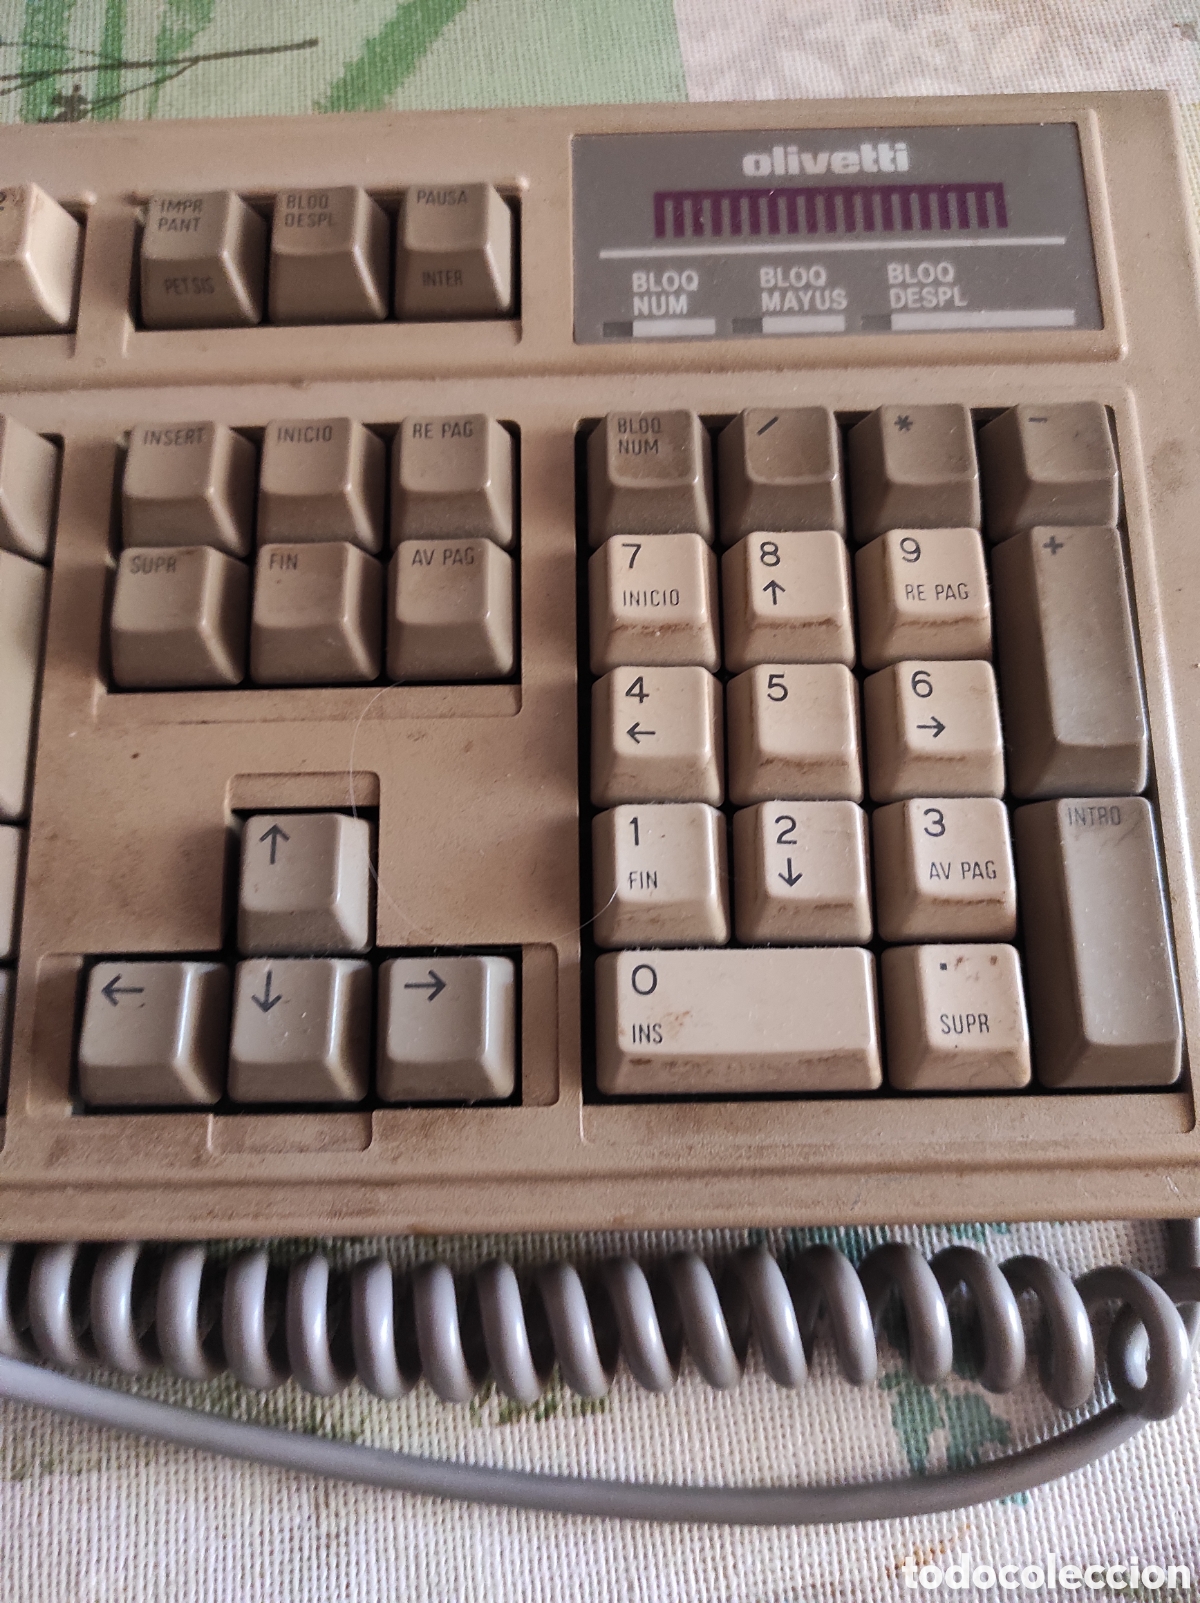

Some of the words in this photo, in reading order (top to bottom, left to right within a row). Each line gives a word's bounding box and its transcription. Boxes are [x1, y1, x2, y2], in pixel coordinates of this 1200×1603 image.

[742, 142, 911, 177] olivetti
[159, 199, 203, 214] IMPR
[416, 189, 468, 206] PAUSA
[157, 217, 201, 232] PANT
[422, 269, 463, 287] INTER
[631, 270, 699, 293] BLOQ
[759, 265, 827, 287] BLOQ
[887, 262, 956, 284] BLOQ
[632, 295, 689, 316] NUM
[761, 290, 847, 313] MAYUS
[889, 287, 968, 308] DESPL
[143, 428, 205, 446] INSERT
[277, 425, 333, 443] INICIO
[413, 422, 435, 440] RE
[441, 420, 474, 438] PAG
[618, 439, 659, 455] NUM
[412, 549, 434, 566] AV
[442, 548, 475, 566] PAG
[621, 543, 643, 569] 7
[760, 541, 781, 567] 8
[900, 538, 921, 562] 9
[130, 556, 177, 573] SUPR
[269, 554, 298, 570] FIN
[622, 589, 681, 607] INICIO
[905, 584, 928, 600] RE
[934, 582, 970, 600] PAG
[625, 677, 650, 703] 4
[767, 675, 788, 701] 5
[911, 670, 933, 698] 6
[923, 808, 946, 837] 3
[1068, 806, 1121, 826] INTRO
[629, 817, 641, 845] 1
[775, 815, 798, 844] 2
[929, 862, 953, 880] AV
[960, 860, 997, 880] PAG
[629, 871, 658, 890] FIN
[631, 964, 658, 995] 0
[631, 1024, 663, 1044] INS
[940, 1014, 990, 1034] SUPR
